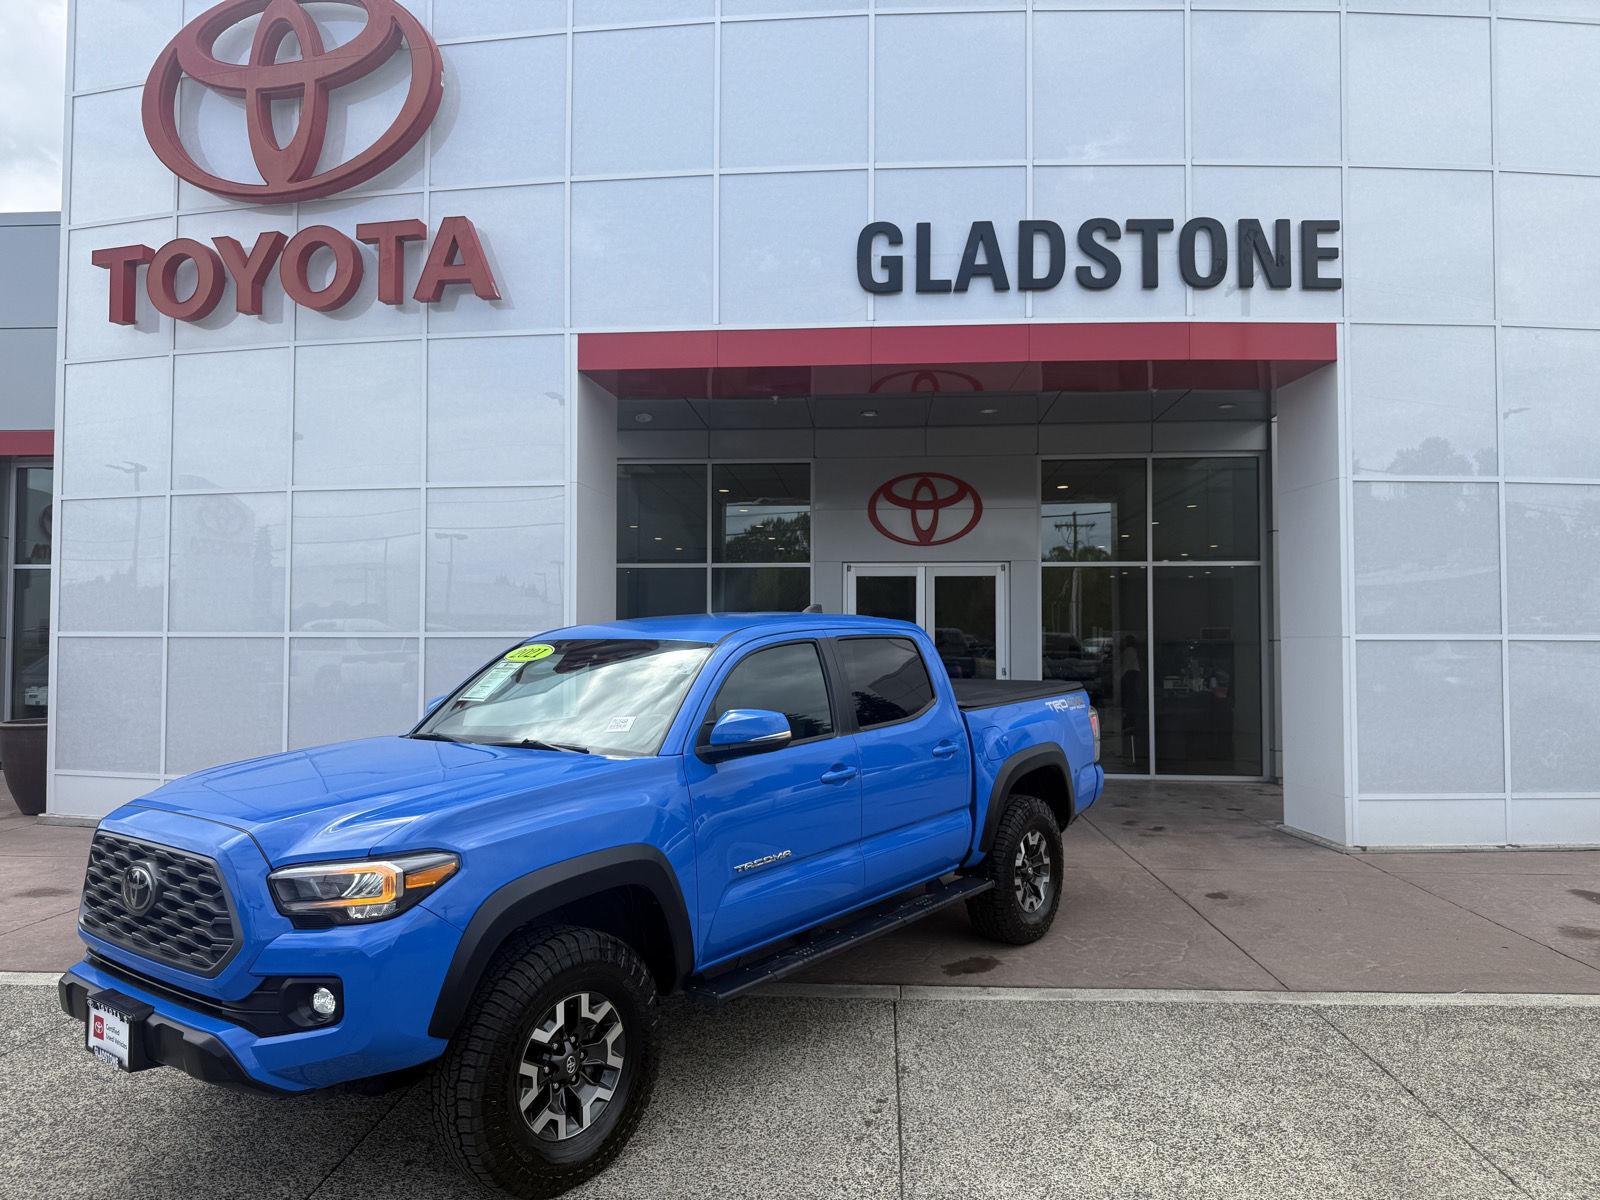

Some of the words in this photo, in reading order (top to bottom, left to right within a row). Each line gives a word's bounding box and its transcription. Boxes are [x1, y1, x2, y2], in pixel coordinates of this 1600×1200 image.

[92, 216, 501, 325] TOYOTA
[856, 217, 1342, 294] GLADSTONE
[1045, 699, 1069, 713] TRD
[733, 849, 793, 873] TACOMA
